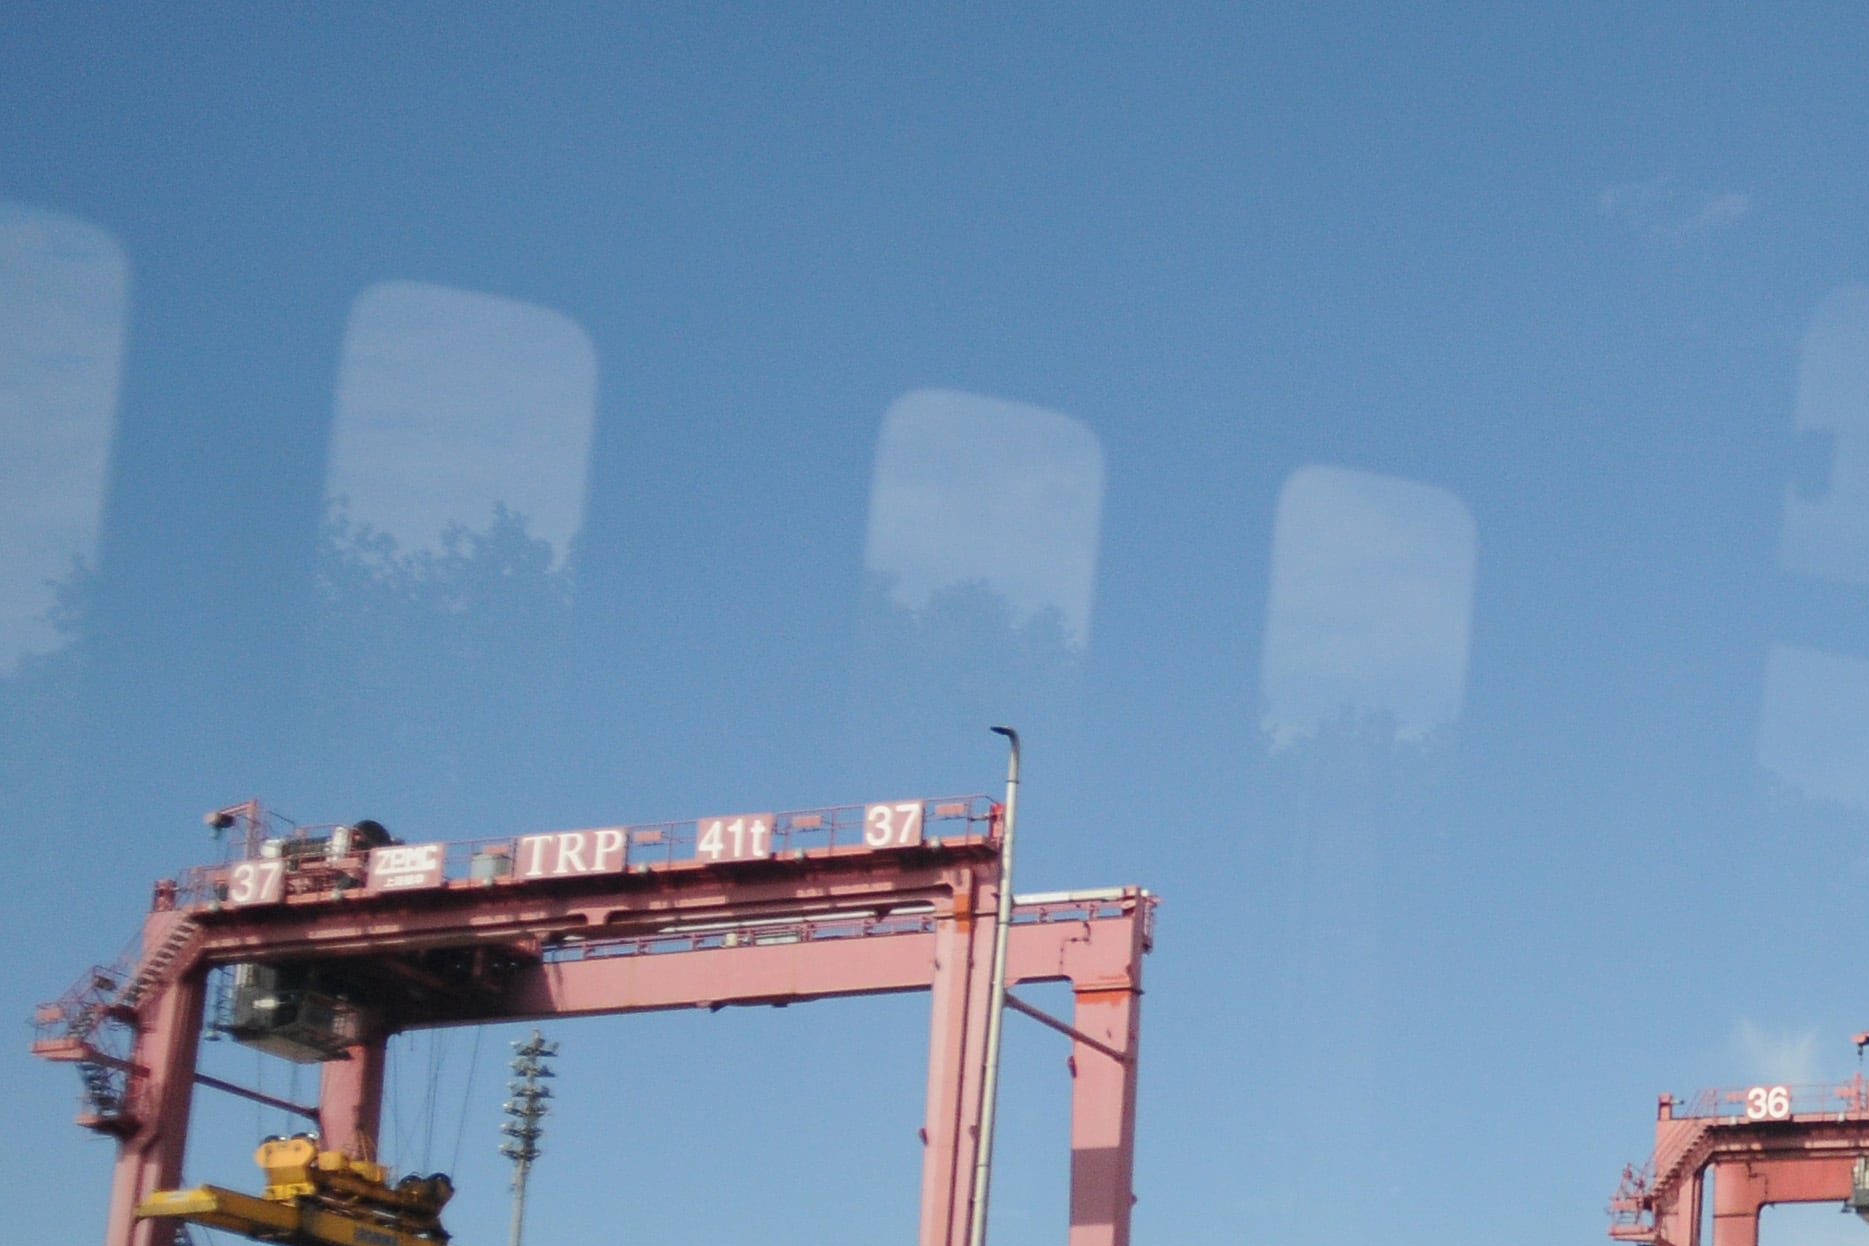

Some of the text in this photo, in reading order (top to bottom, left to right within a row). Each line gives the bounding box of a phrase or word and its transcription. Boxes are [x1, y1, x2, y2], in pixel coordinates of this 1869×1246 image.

[697, 818, 765, 859] 41t
[865, 804, 921, 847] 37
[521, 830, 627, 877] TRP
[231, 862, 280, 902] 37
[1746, 1087, 1790, 1120] 36
